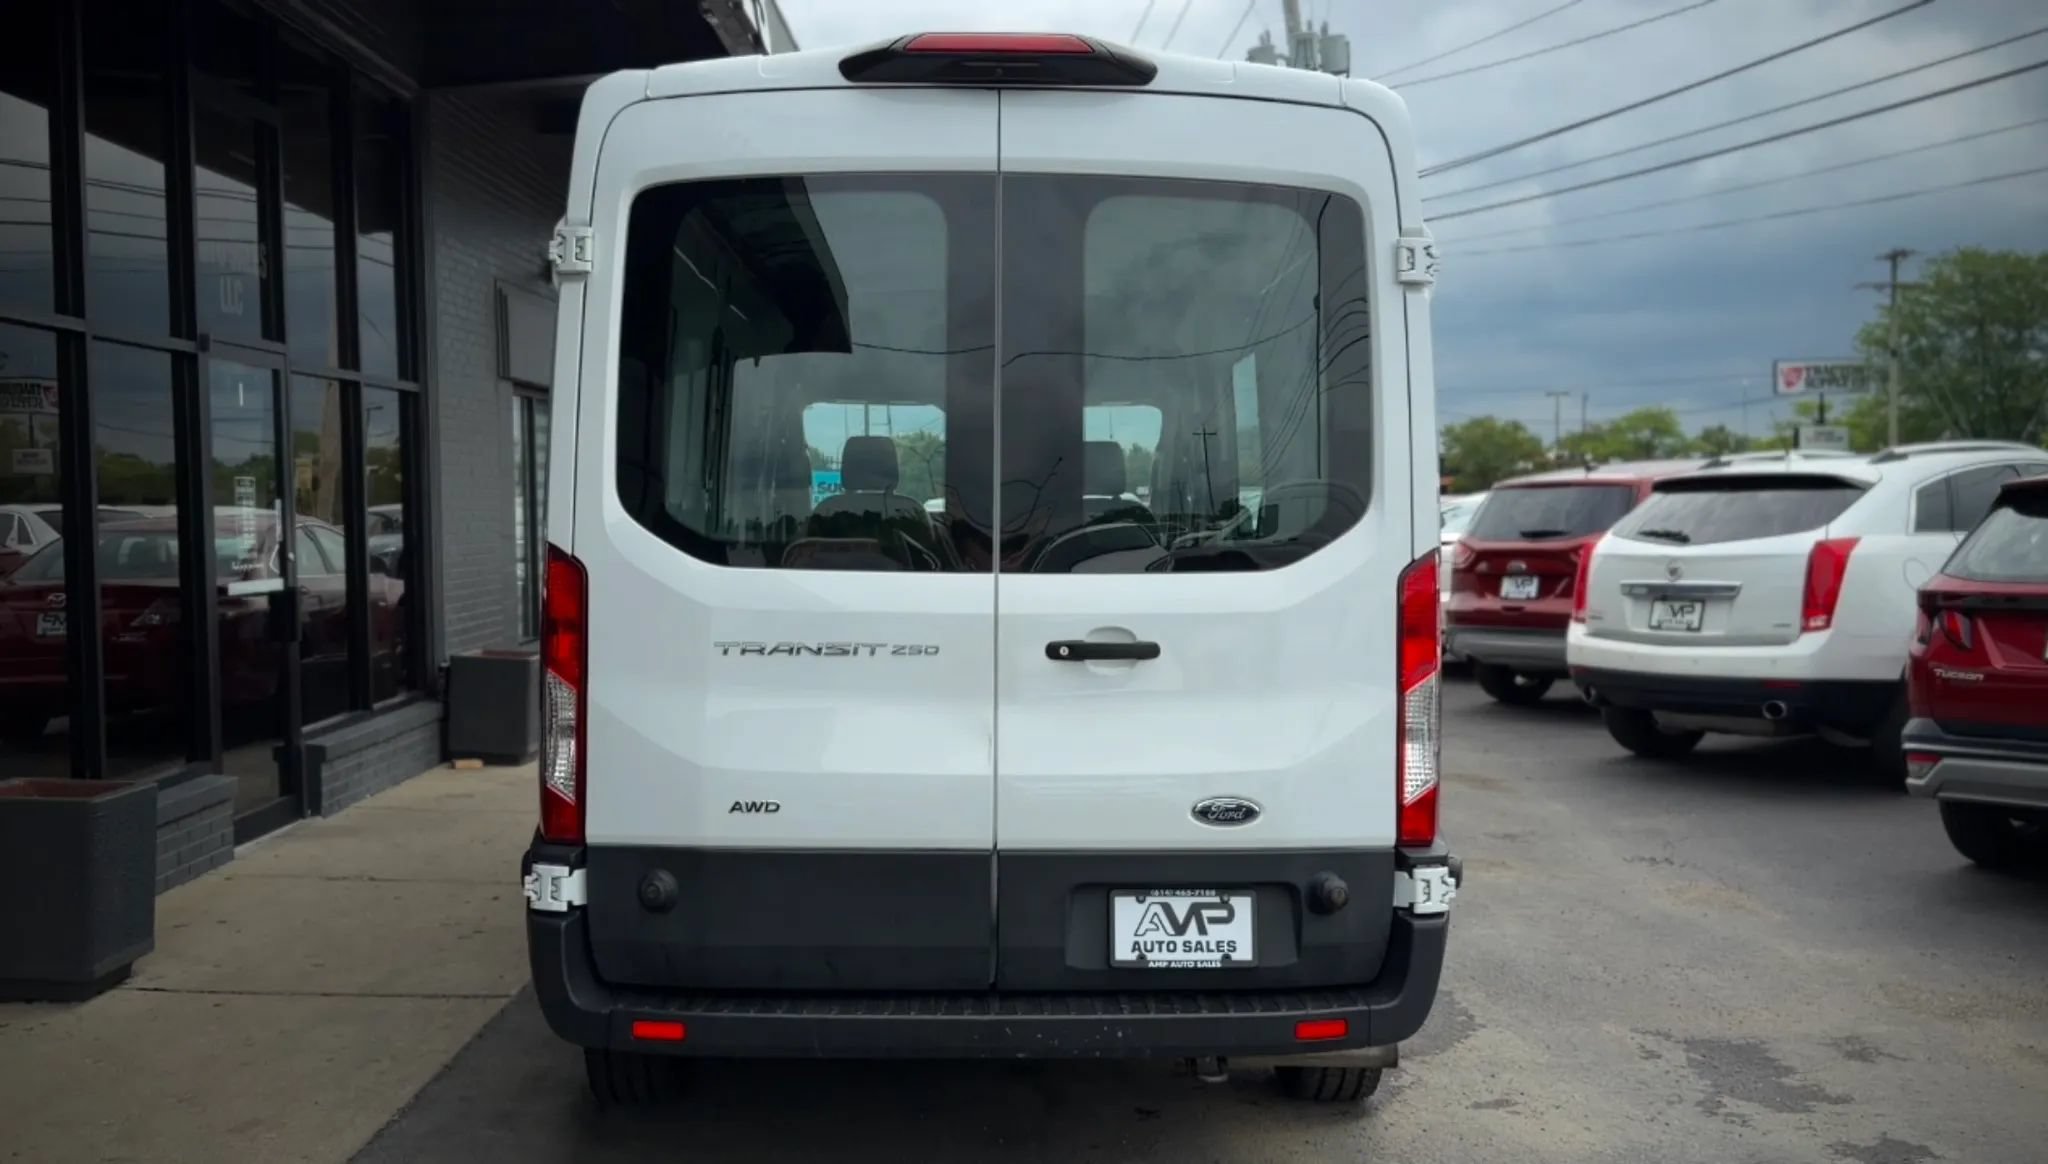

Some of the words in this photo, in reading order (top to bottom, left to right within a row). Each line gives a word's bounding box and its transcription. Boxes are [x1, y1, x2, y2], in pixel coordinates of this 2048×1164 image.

[713, 641, 888, 656] TRANSIT
[890, 644, 940, 656] 250
[728, 801, 780, 814] AWD
[1207, 802, 1247, 820] Ford
[1131, 940, 1177, 953] AUTO
[1182, 940, 1237, 953] SALES
[1147, 960, 1168, 968] AMP
[1170, 960, 1195, 968] AUTO
[1197, 960, 1222, 968] SALES
